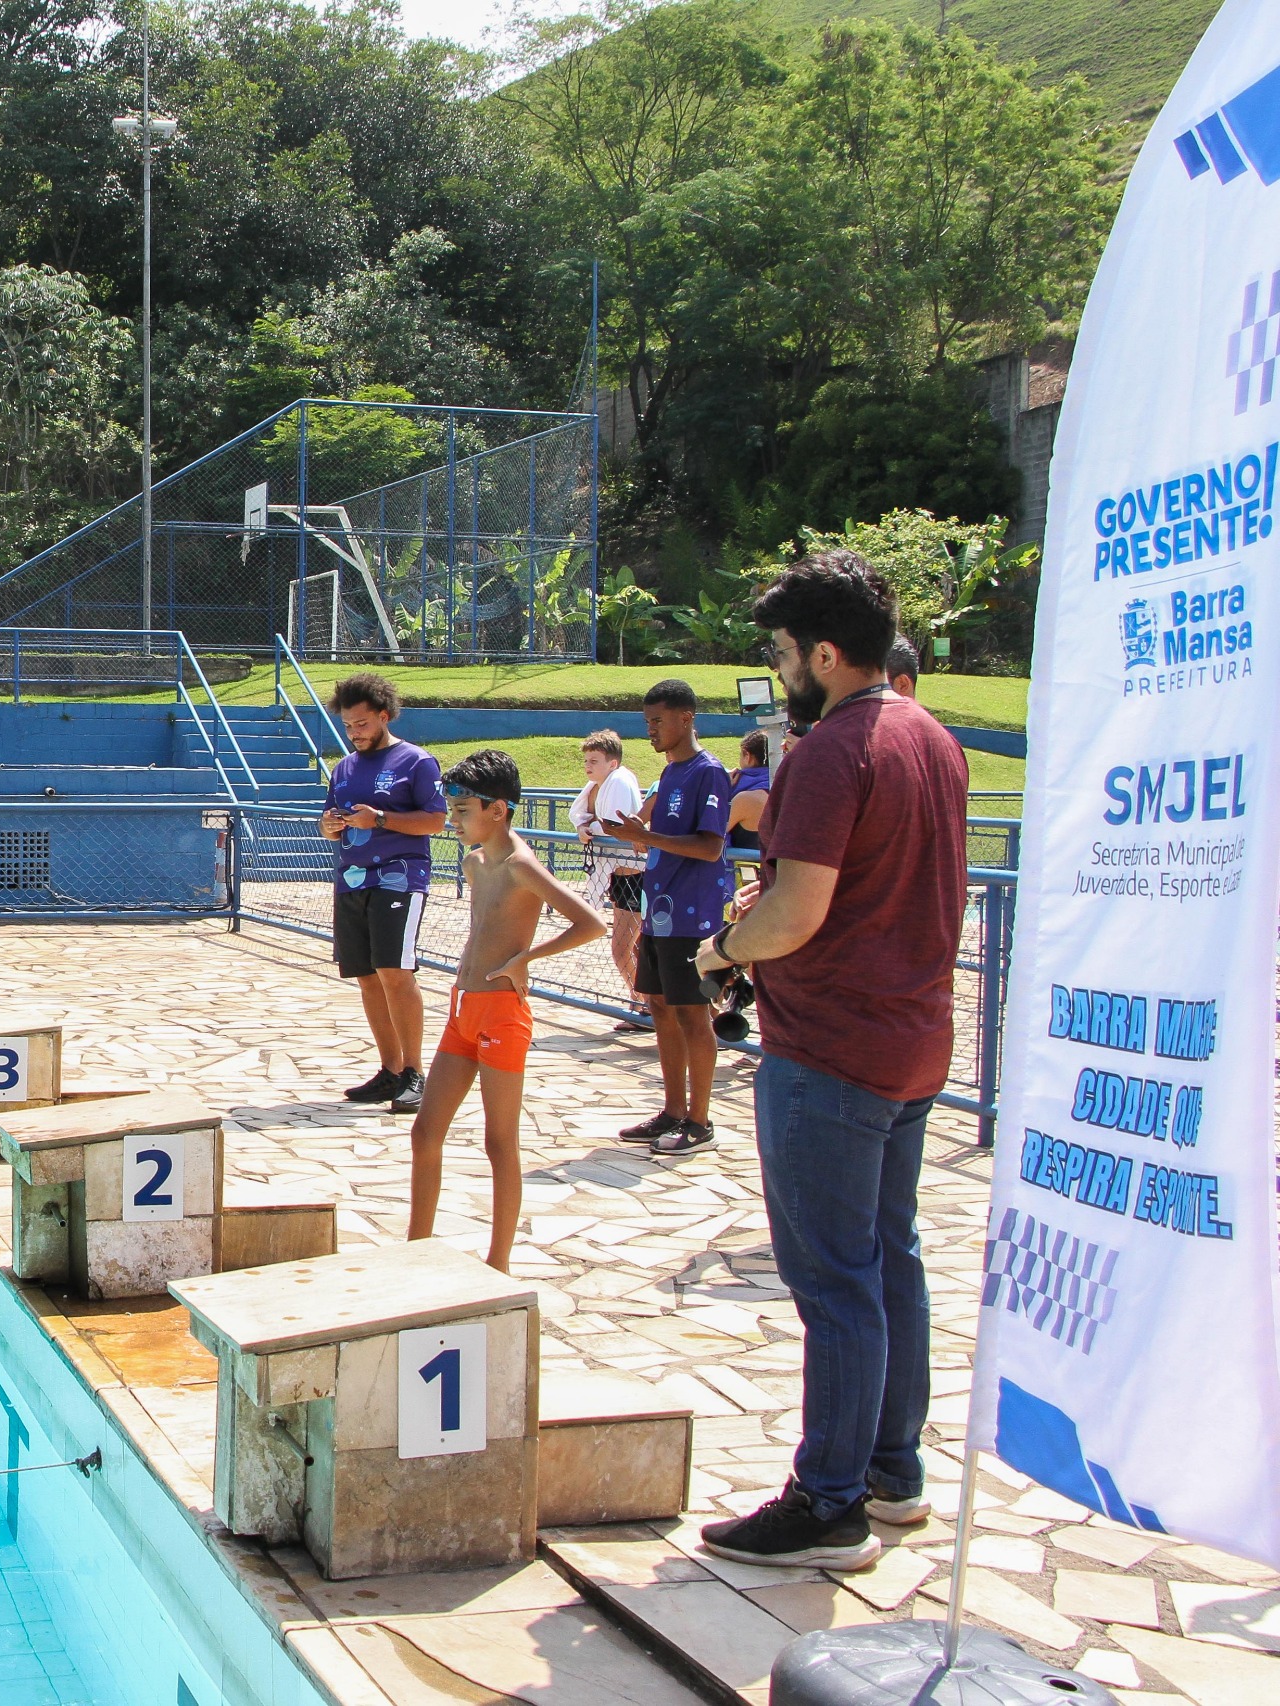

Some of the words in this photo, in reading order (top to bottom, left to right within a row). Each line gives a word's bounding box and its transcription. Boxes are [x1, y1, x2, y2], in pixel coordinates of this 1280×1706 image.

[1094, 454, 1262, 538] GOVERNO
[1171, 584, 1245, 628] Barra
[1163, 621, 1253, 667] Mansa
[1123, 656, 1253, 698] PREFEITURA
[1103, 754, 1246, 826] SMJEL
[1167, 834, 1238, 871] Municipal
[1160, 871, 1221, 903] Esporte
[1048, 983, 1147, 1055] BARRA
[1071, 1067, 1172, 1141] CIDADE
[133, 1149, 173, 1206] 2
[1020, 1127, 1133, 1216] RESPIRA
[418, 1348, 460, 1431] 1
